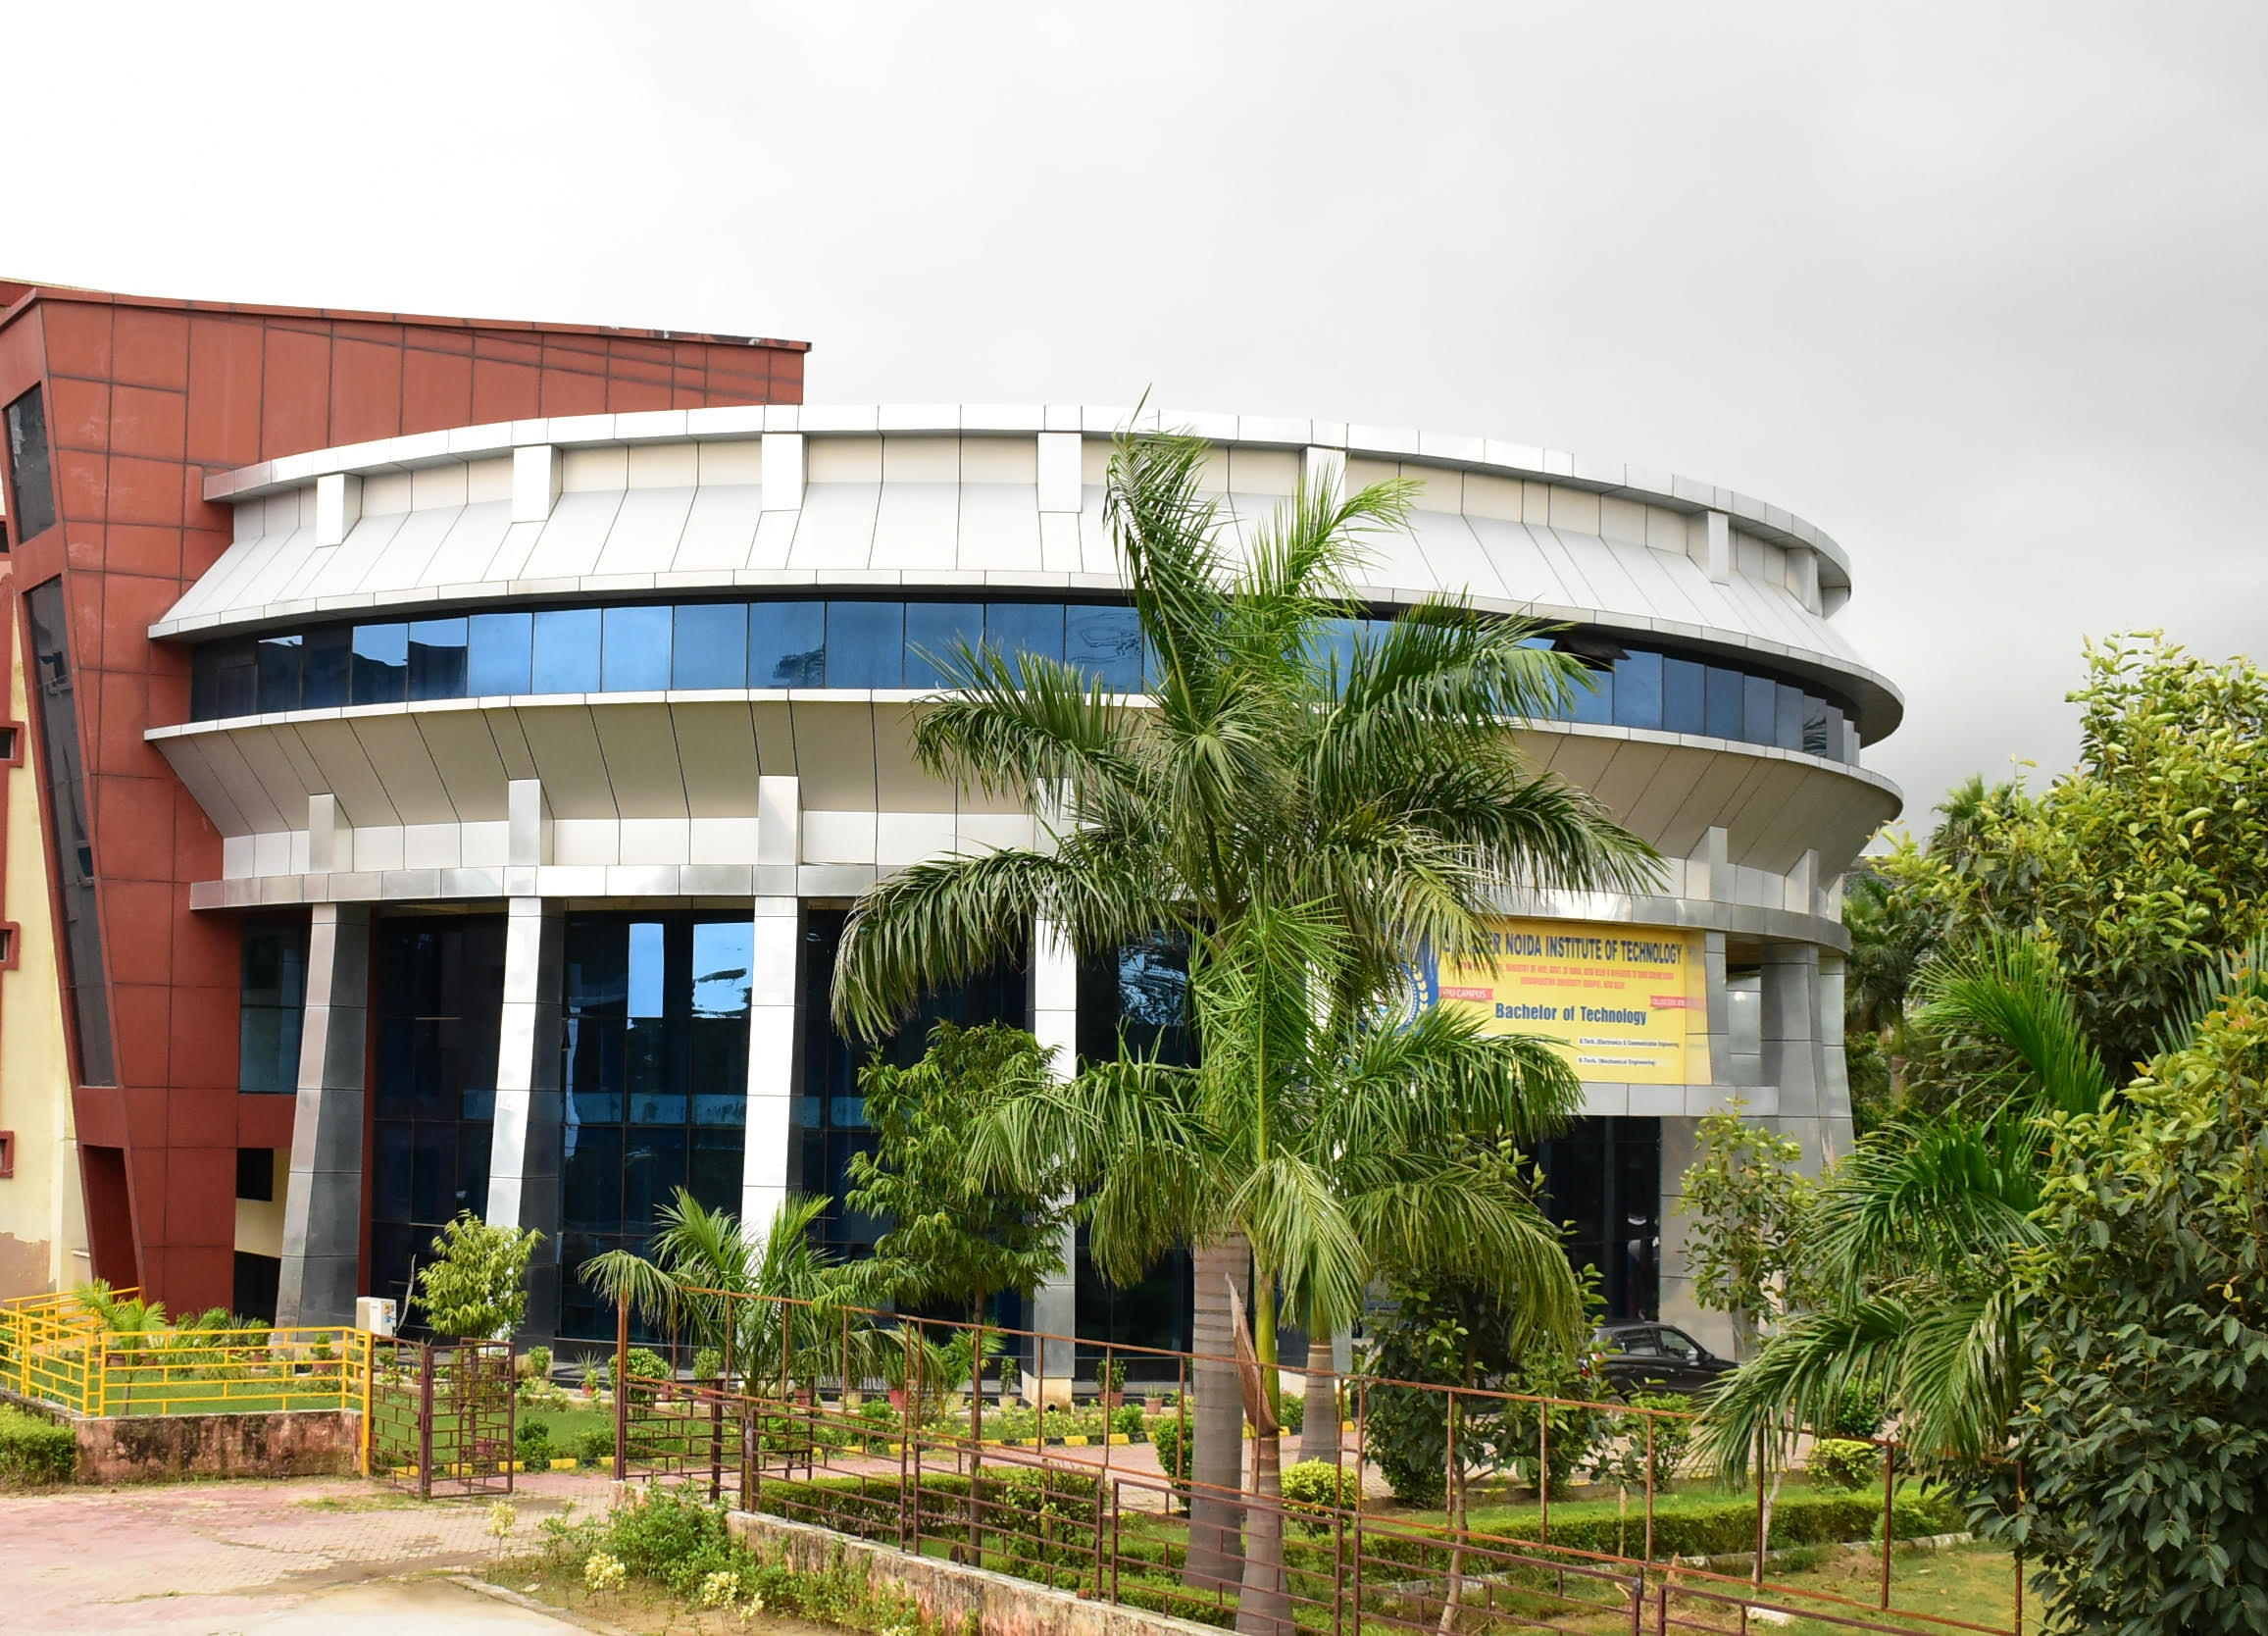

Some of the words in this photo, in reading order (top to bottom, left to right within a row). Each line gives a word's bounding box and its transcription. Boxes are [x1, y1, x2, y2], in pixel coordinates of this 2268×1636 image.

[1505, 933, 1542, 956] NOIDA
[1545, 935, 1602, 960] INSTITUTE
[1605, 939, 1618, 961] OF
[1621, 940, 1683, 964] TECHNOLOGY
[1456, 989, 1487, 998] CAMPUS
[1495, 1002, 1557, 1021] Bachelor
[1563, 1005, 1576, 1021] of
[1581, 1006, 1647, 1026] Technology
